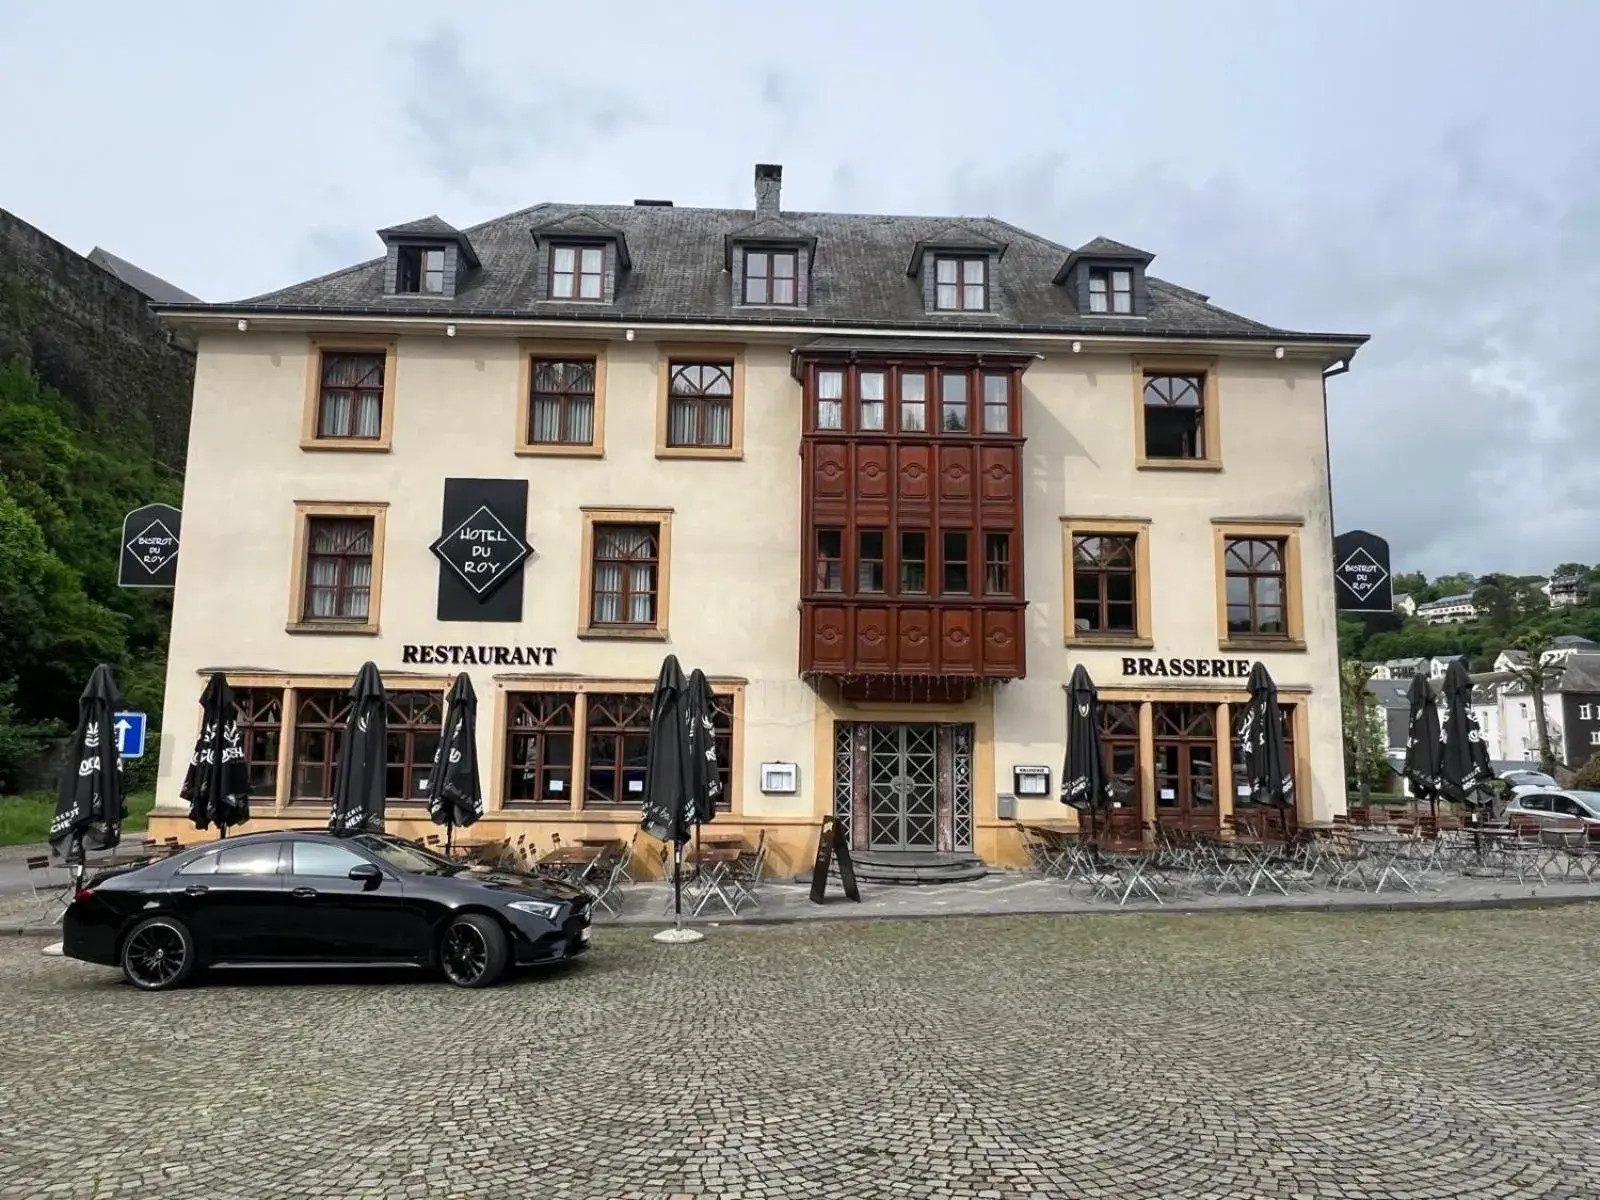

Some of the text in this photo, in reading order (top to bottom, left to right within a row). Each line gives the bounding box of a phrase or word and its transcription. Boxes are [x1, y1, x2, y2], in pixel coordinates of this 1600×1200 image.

[460, 527, 507, 542] HOTEL
[138, 537, 172, 546] BISTROT
[472, 545, 491, 557] DU
[143, 555, 165, 563] ROY
[464, 561, 500, 573] ROY
[1345, 564, 1376, 573] BISTROT
[1352, 582, 1372, 590] ROY
[402, 644, 557, 666] RESTAURANT
[1121, 657, 1250, 678] BRASSERIE
